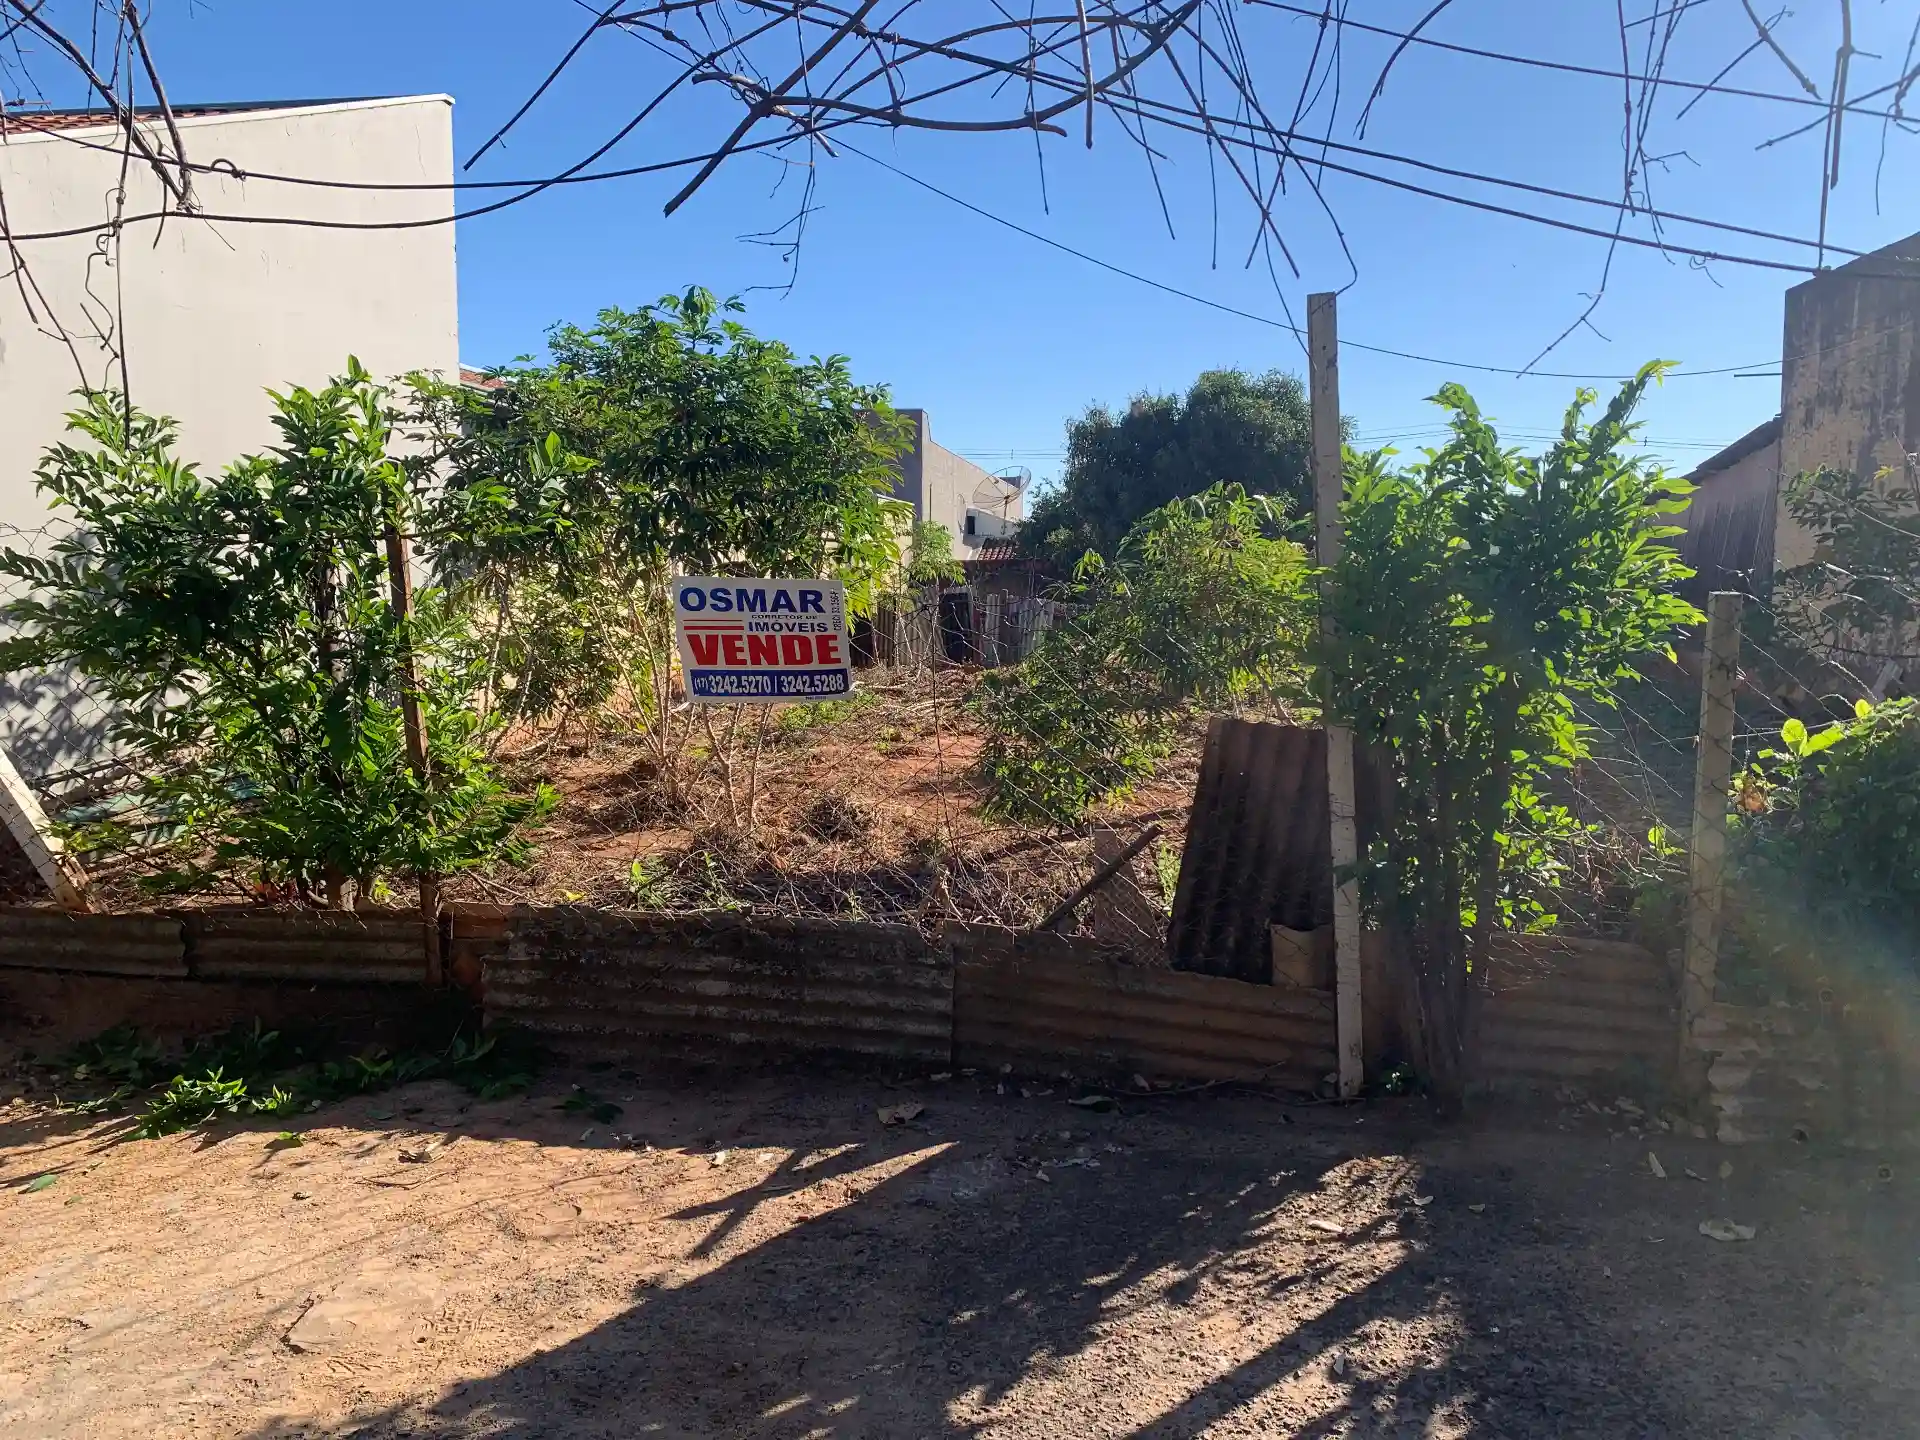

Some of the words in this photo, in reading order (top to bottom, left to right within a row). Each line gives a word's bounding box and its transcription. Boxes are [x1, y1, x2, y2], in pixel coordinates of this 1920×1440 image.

[679, 587, 826, 613] OSMAR
[748, 619, 829, 633] IMÓVEIS
[832, 615, 842, 631] CRECI
[686, 634, 842, 665] VENDE
[782, 674, 845, 693] 3242.5288
